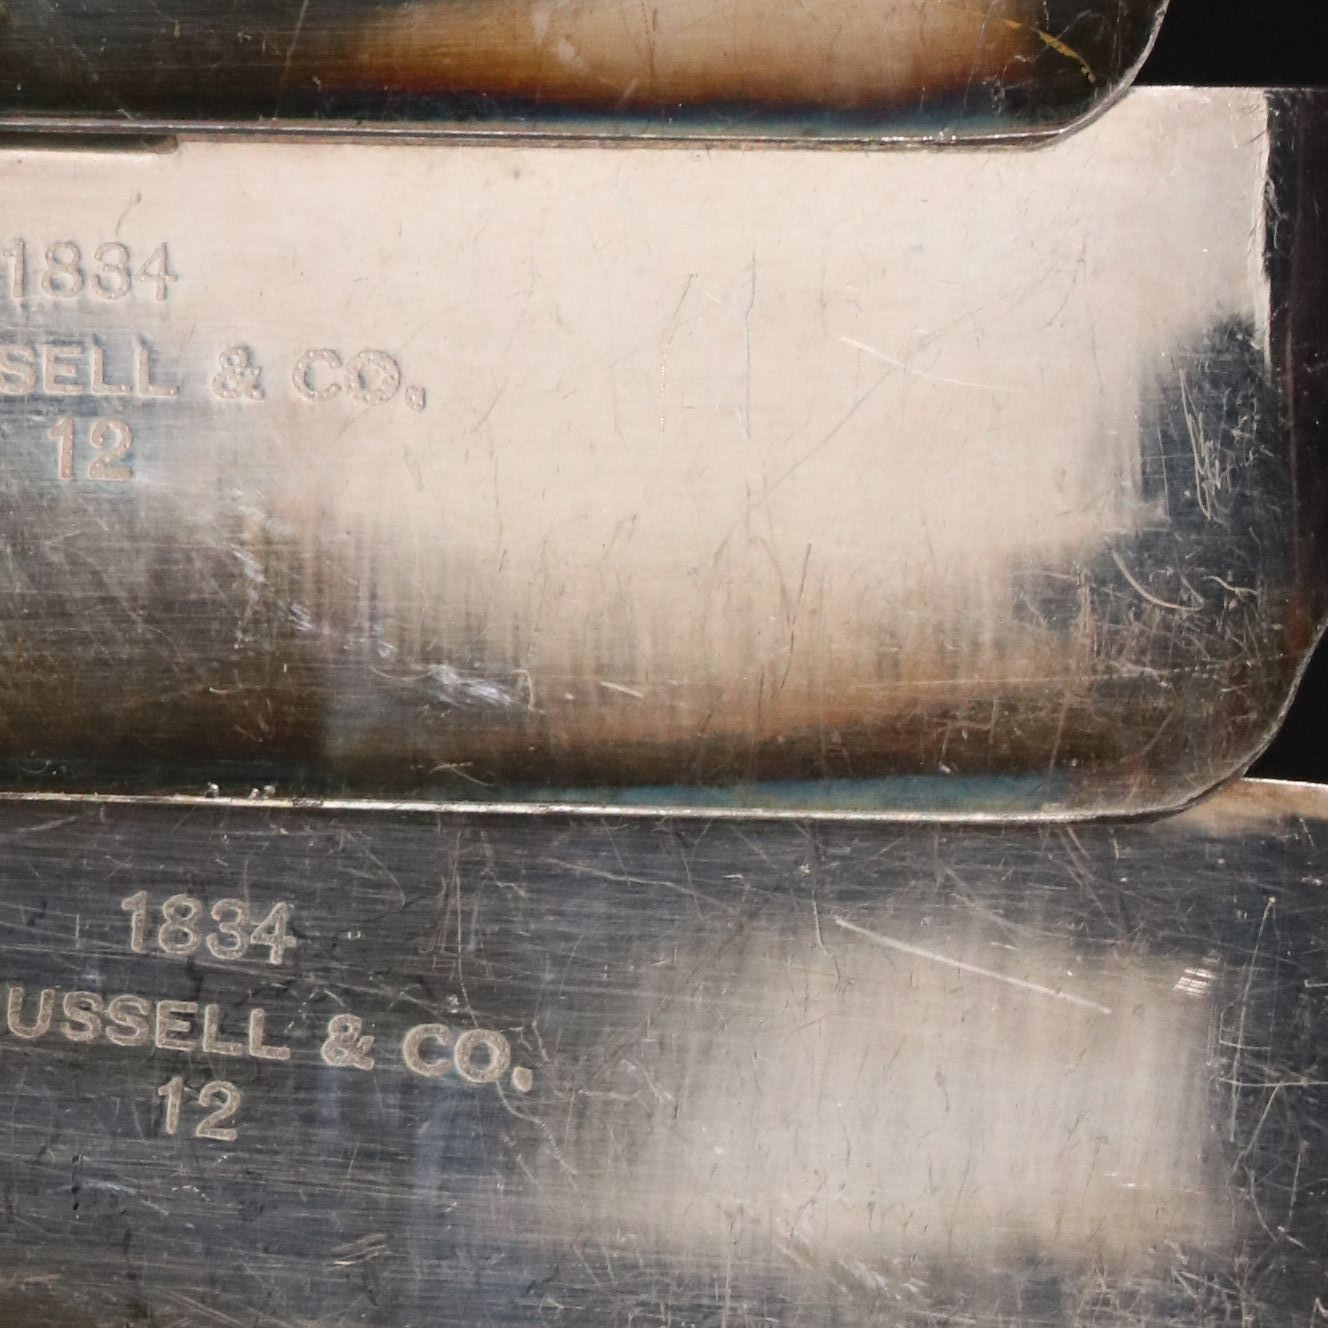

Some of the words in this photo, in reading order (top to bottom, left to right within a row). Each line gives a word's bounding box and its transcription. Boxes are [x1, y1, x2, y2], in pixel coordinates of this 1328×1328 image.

[3, 240, 178, 302] 1834
[212, 346, 265, 400] &
[291, 348, 427, 411] CO.
[50, 418, 135, 481] 12
[120, 891, 298, 966] 1834
[320, 1014, 375, 1070] &
[402, 1023, 533, 1093] CO.
[158, 1076, 241, 1141] 12
